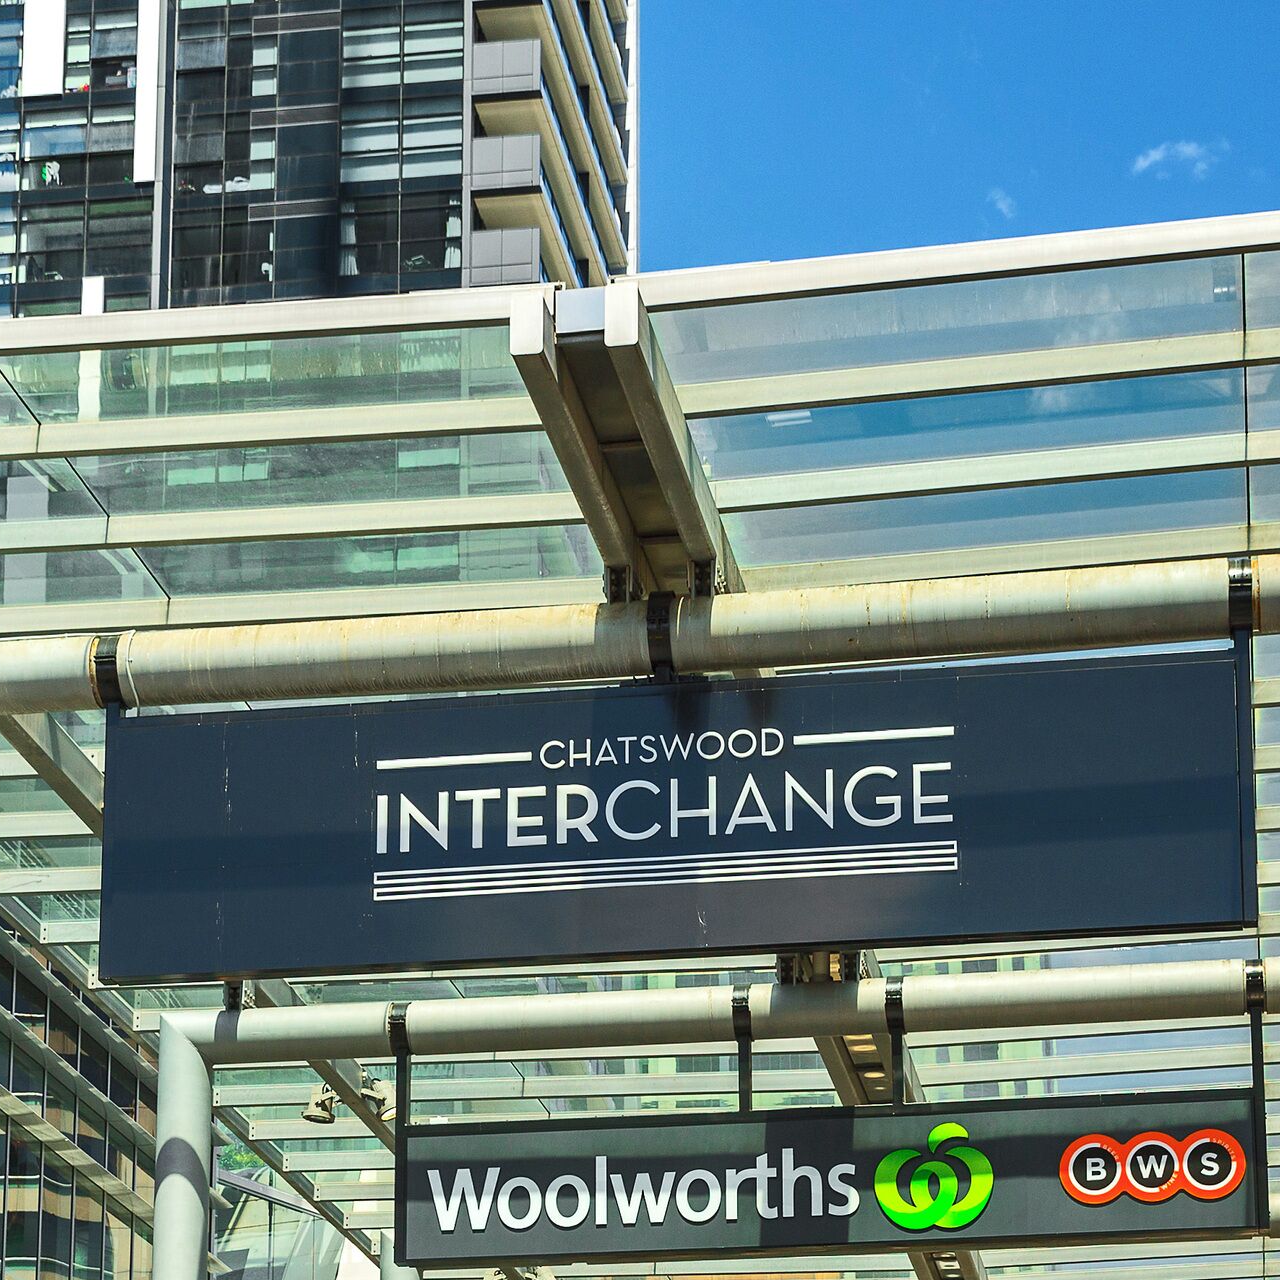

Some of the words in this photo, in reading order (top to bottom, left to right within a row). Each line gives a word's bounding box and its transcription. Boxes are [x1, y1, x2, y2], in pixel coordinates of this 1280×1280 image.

[538, 727, 785, 771] CHATSWOOD
[373, 761, 954, 855] INTERCHANGE
[1086, 1152, 1220, 1182] BWS
[1212, 1137, 1237, 1161] SPIRITS
[426, 1145, 860, 1236] Woolworths
[1159, 1172, 1178, 1190] WINE
